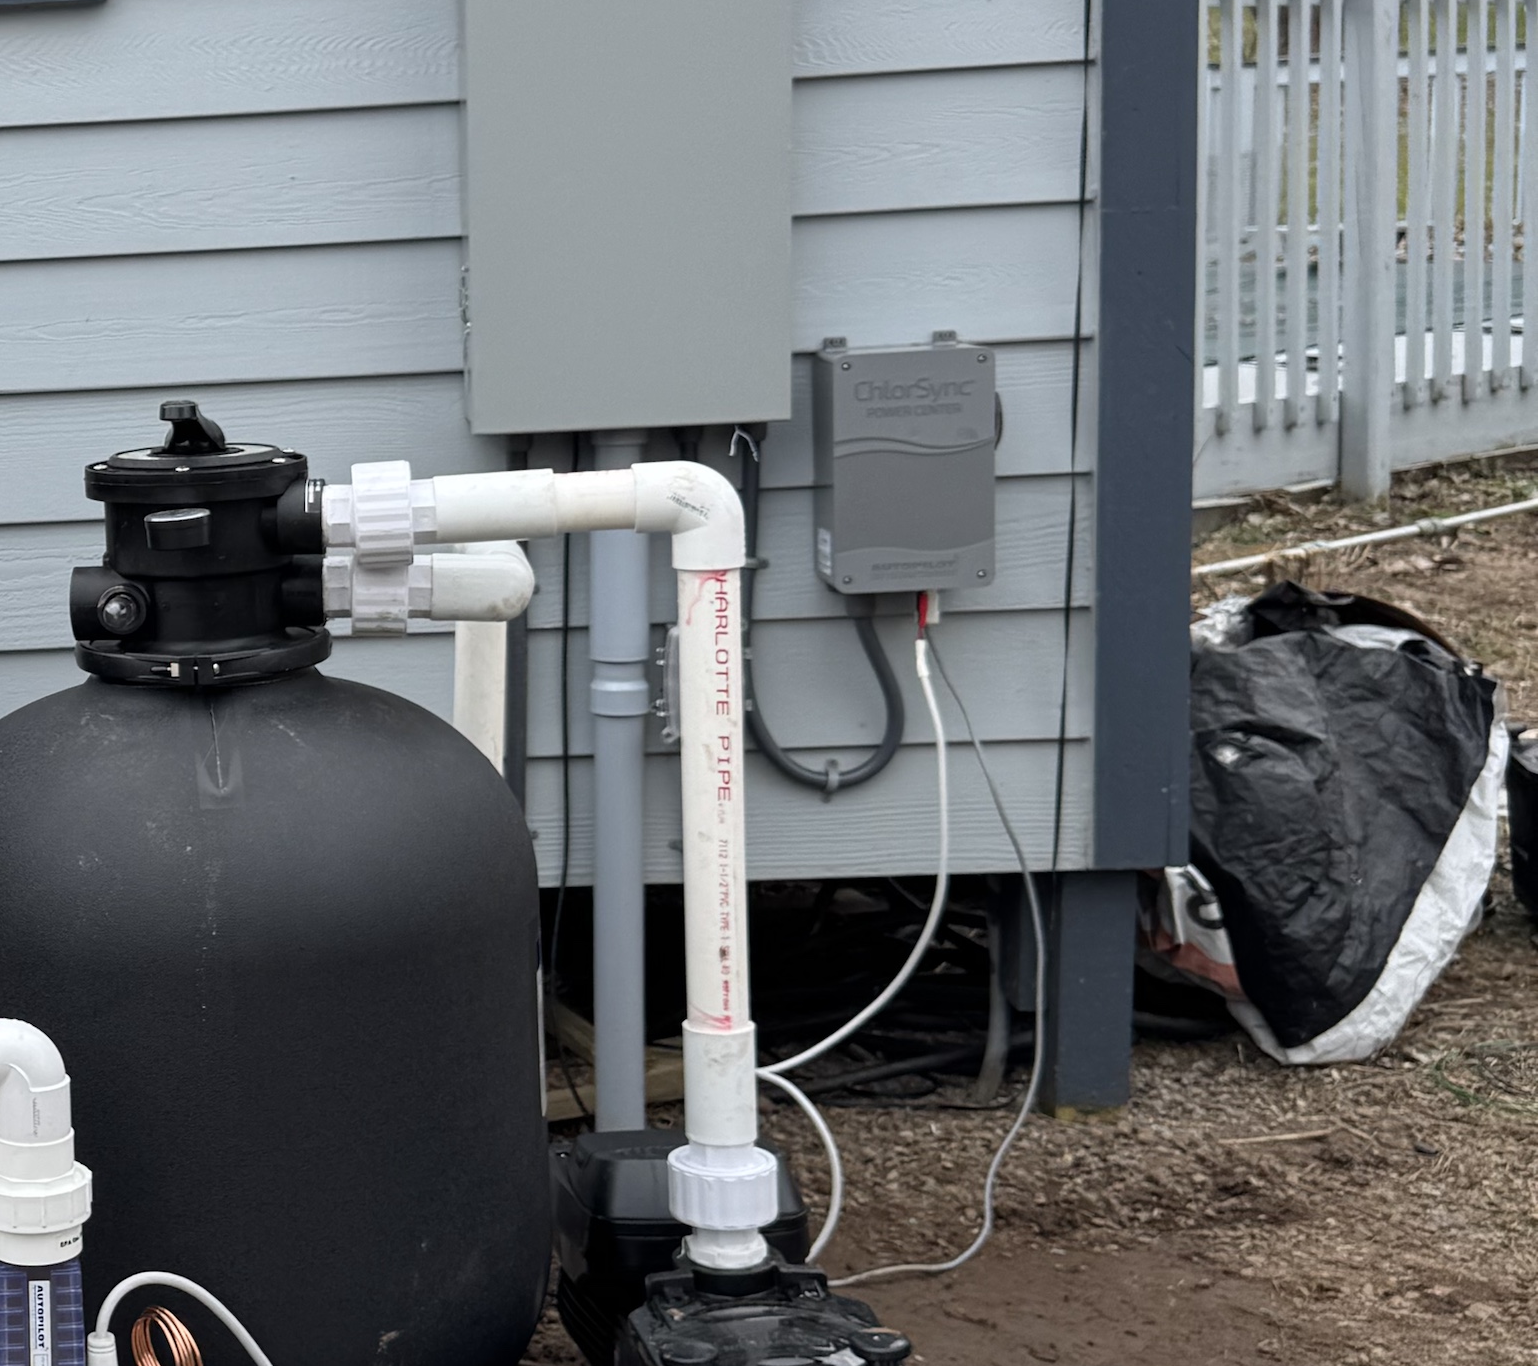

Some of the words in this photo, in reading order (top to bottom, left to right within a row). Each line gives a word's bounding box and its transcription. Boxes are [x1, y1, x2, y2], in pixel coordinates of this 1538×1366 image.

[853, 377, 976, 402] ChlorSync
[866, 406, 912, 418] POWER
[914, 403, 961, 416] CENTER
[717, 735, 732, 802] PIPE
[37, 1285, 45, 1348] AUTOPILOT
